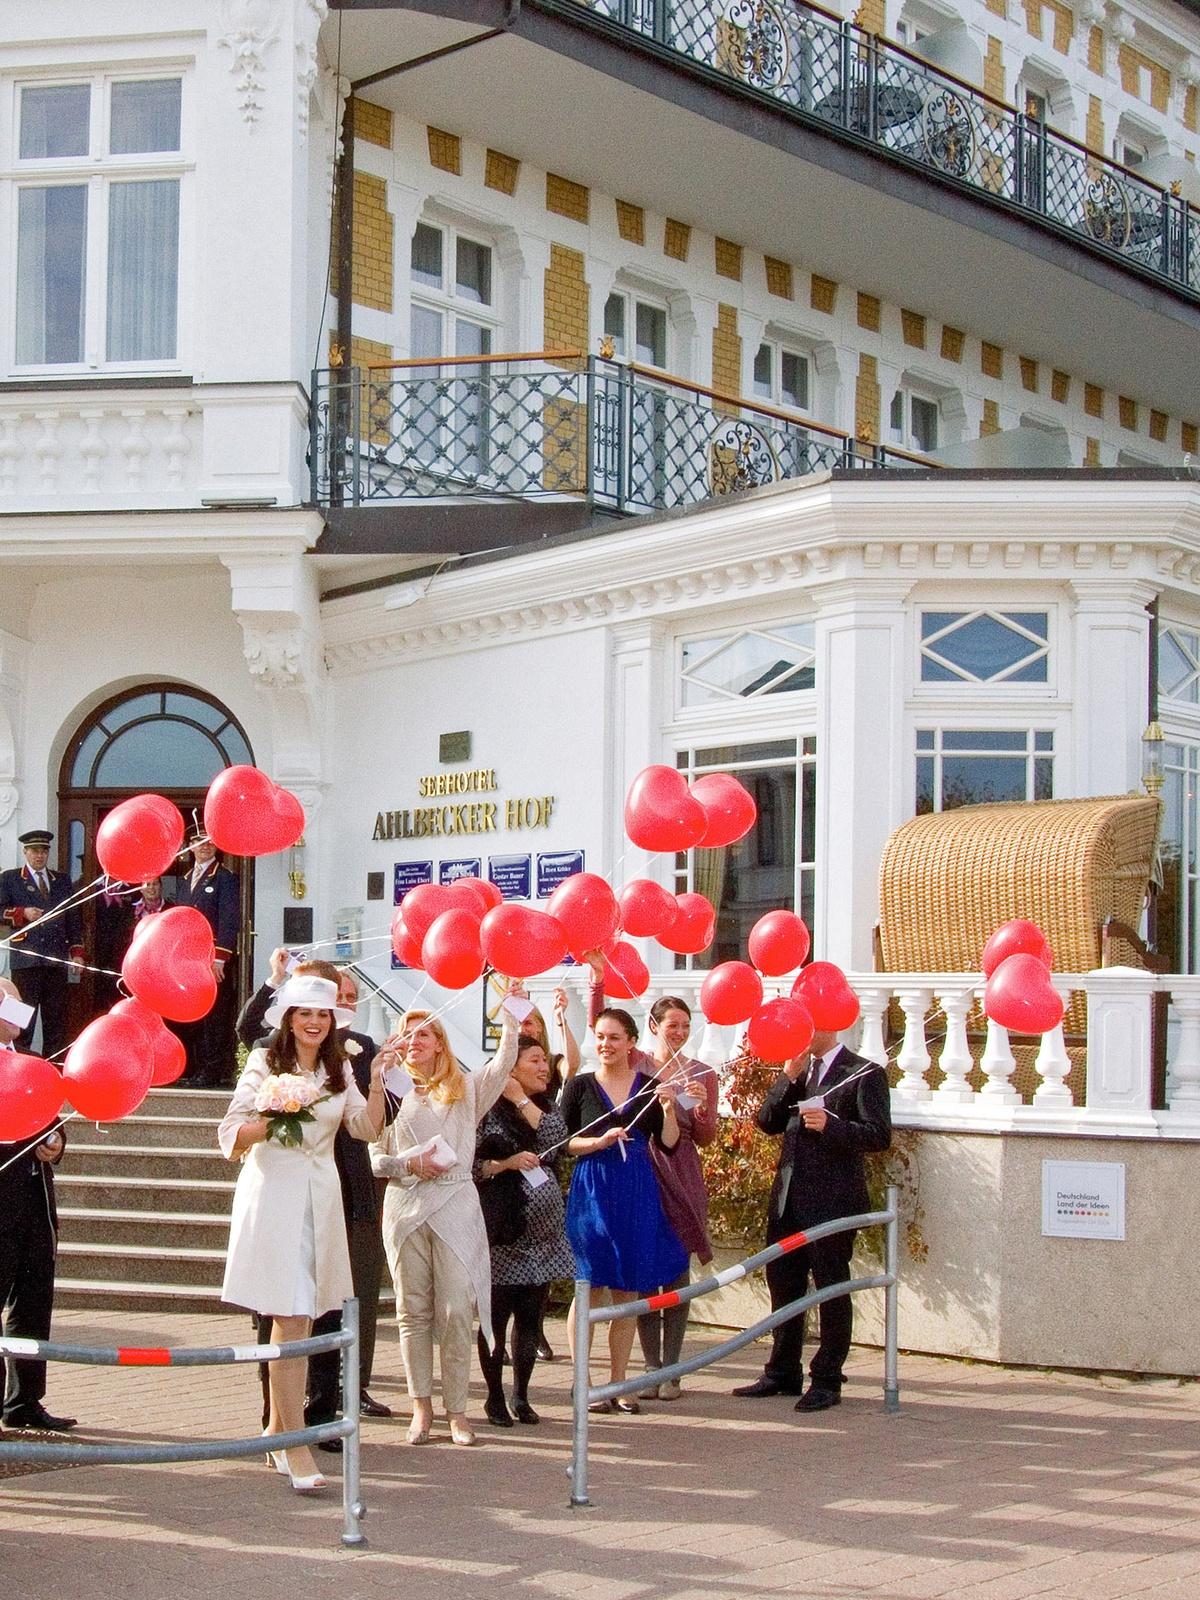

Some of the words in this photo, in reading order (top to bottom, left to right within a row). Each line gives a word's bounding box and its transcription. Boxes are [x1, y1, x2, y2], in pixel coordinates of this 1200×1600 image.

[417, 768, 498, 798] SEEHOTEL
[371, 801, 497, 841] AHLBECKER
[503, 795, 555, 832] HOF
[1057, 1192, 1100, 1200] Deutschland
